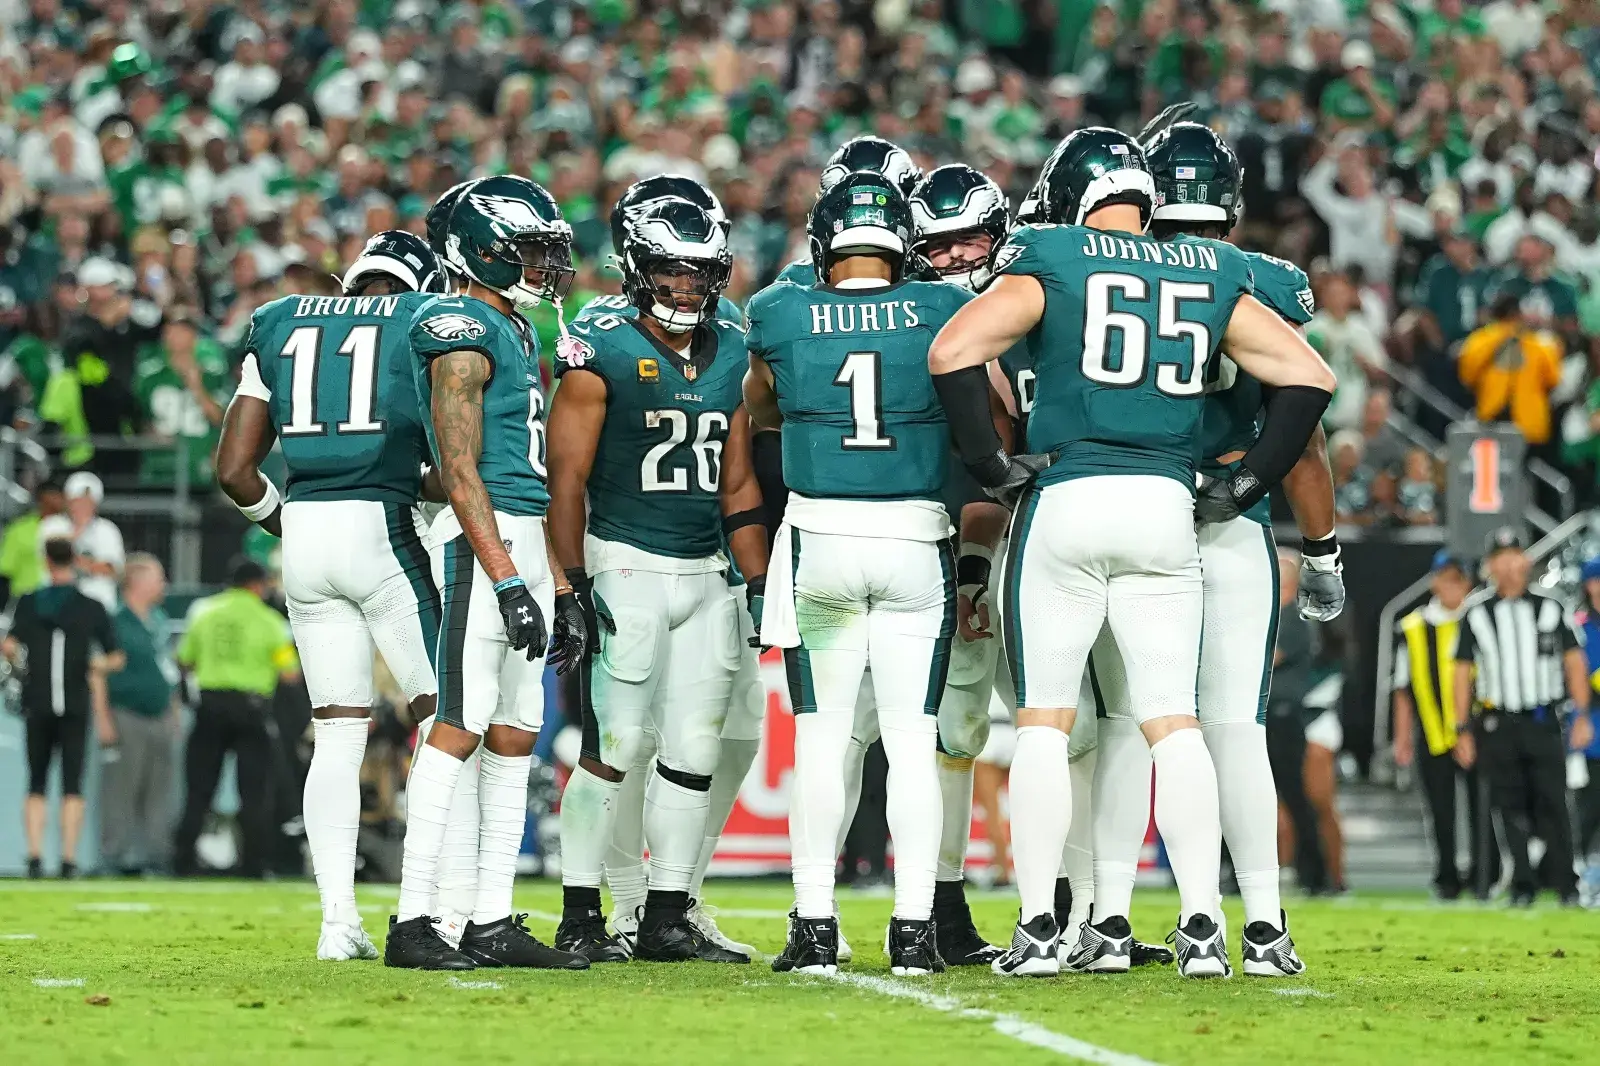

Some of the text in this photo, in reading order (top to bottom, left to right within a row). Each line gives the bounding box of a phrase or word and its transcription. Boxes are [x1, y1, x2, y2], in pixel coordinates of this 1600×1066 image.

[1082, 232, 1218, 272] JOHNSON
[293, 296, 399, 317] BROWN
[809, 301, 920, 334] HURTS
[1079, 271, 1215, 400] 65
[278, 324, 388, 436] 11
[674, 393, 704, 402] EAGLES
[832, 351, 897, 451] 1
[639, 407, 729, 494] 26
[1468, 438, 1503, 514] 1
